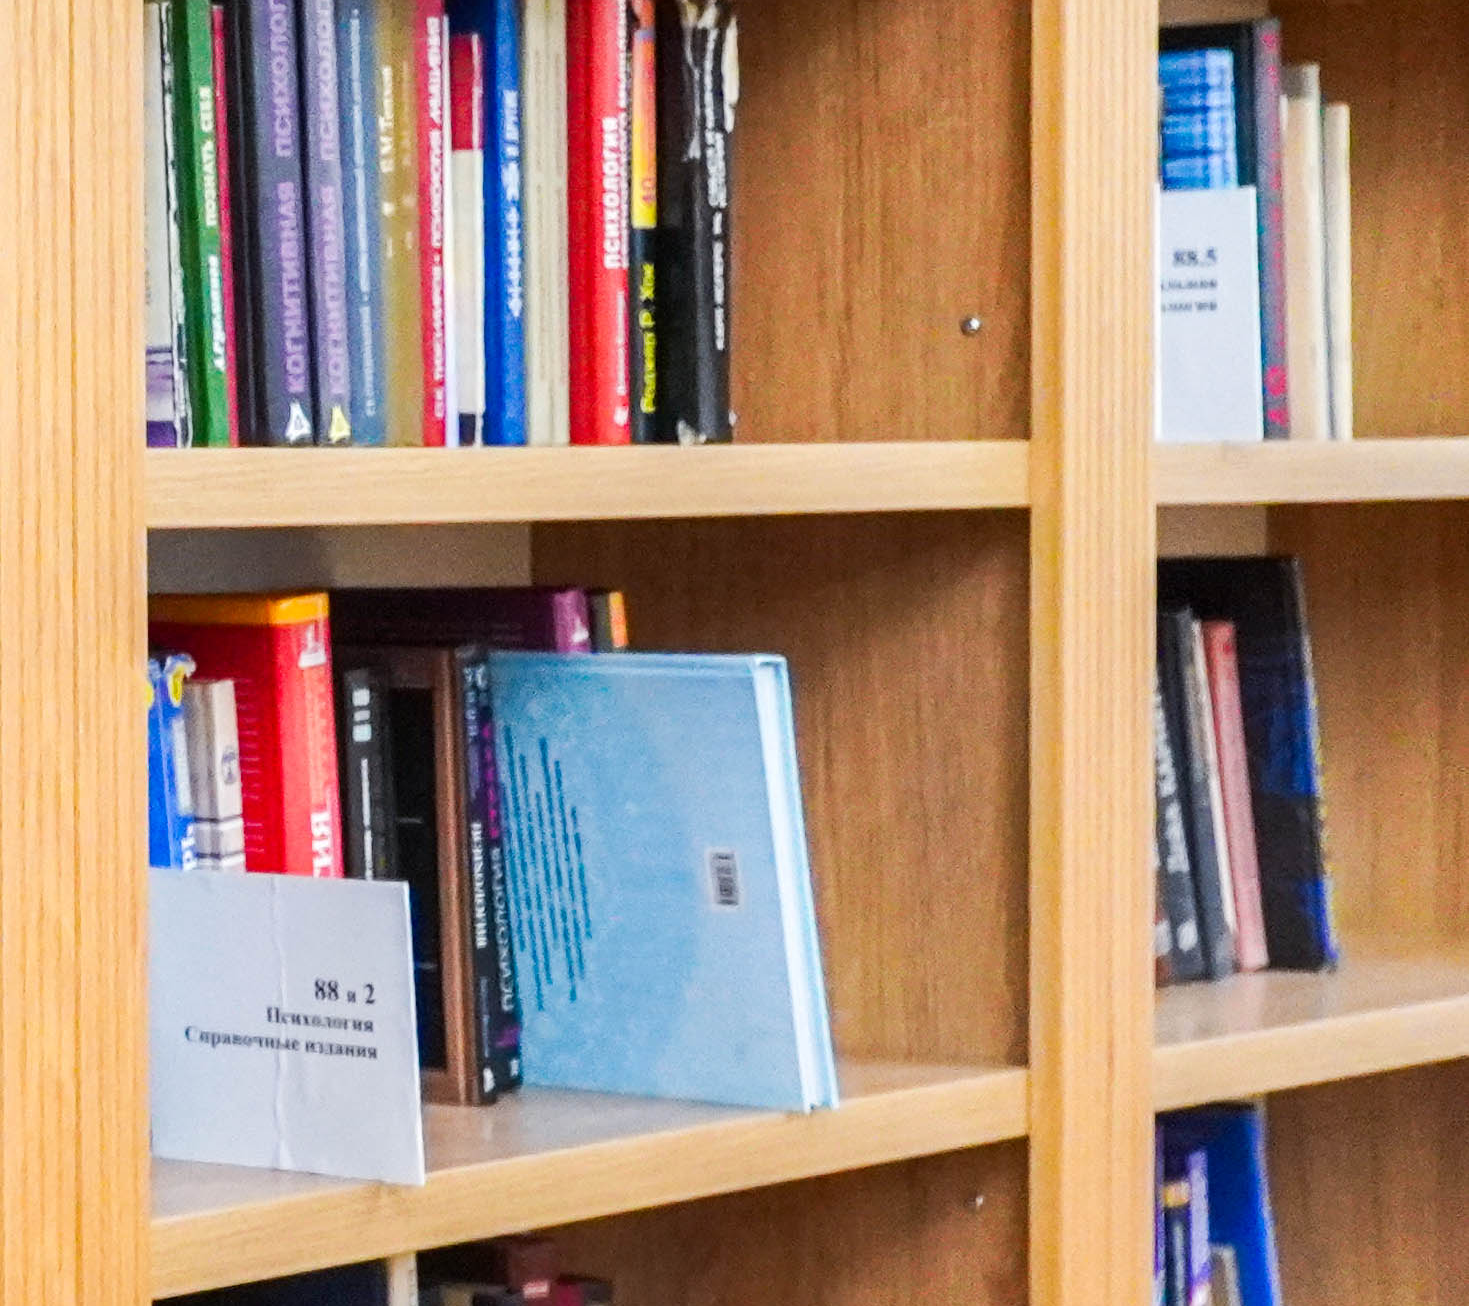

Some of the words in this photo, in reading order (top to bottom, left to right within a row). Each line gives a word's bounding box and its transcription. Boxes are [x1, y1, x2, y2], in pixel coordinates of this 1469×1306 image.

[602, 117, 620, 270] ПСИХОЛОГИЯ
[276, 181, 309, 394] КОГНИТИВНАЯ
[314, 978, 339, 1001] 88
[364, 984, 376, 1004] 2
[267, 1006, 375, 1033] Психология
[185, 1025, 300, 1053] Справочные
[304, 1037, 378, 1060] издания
